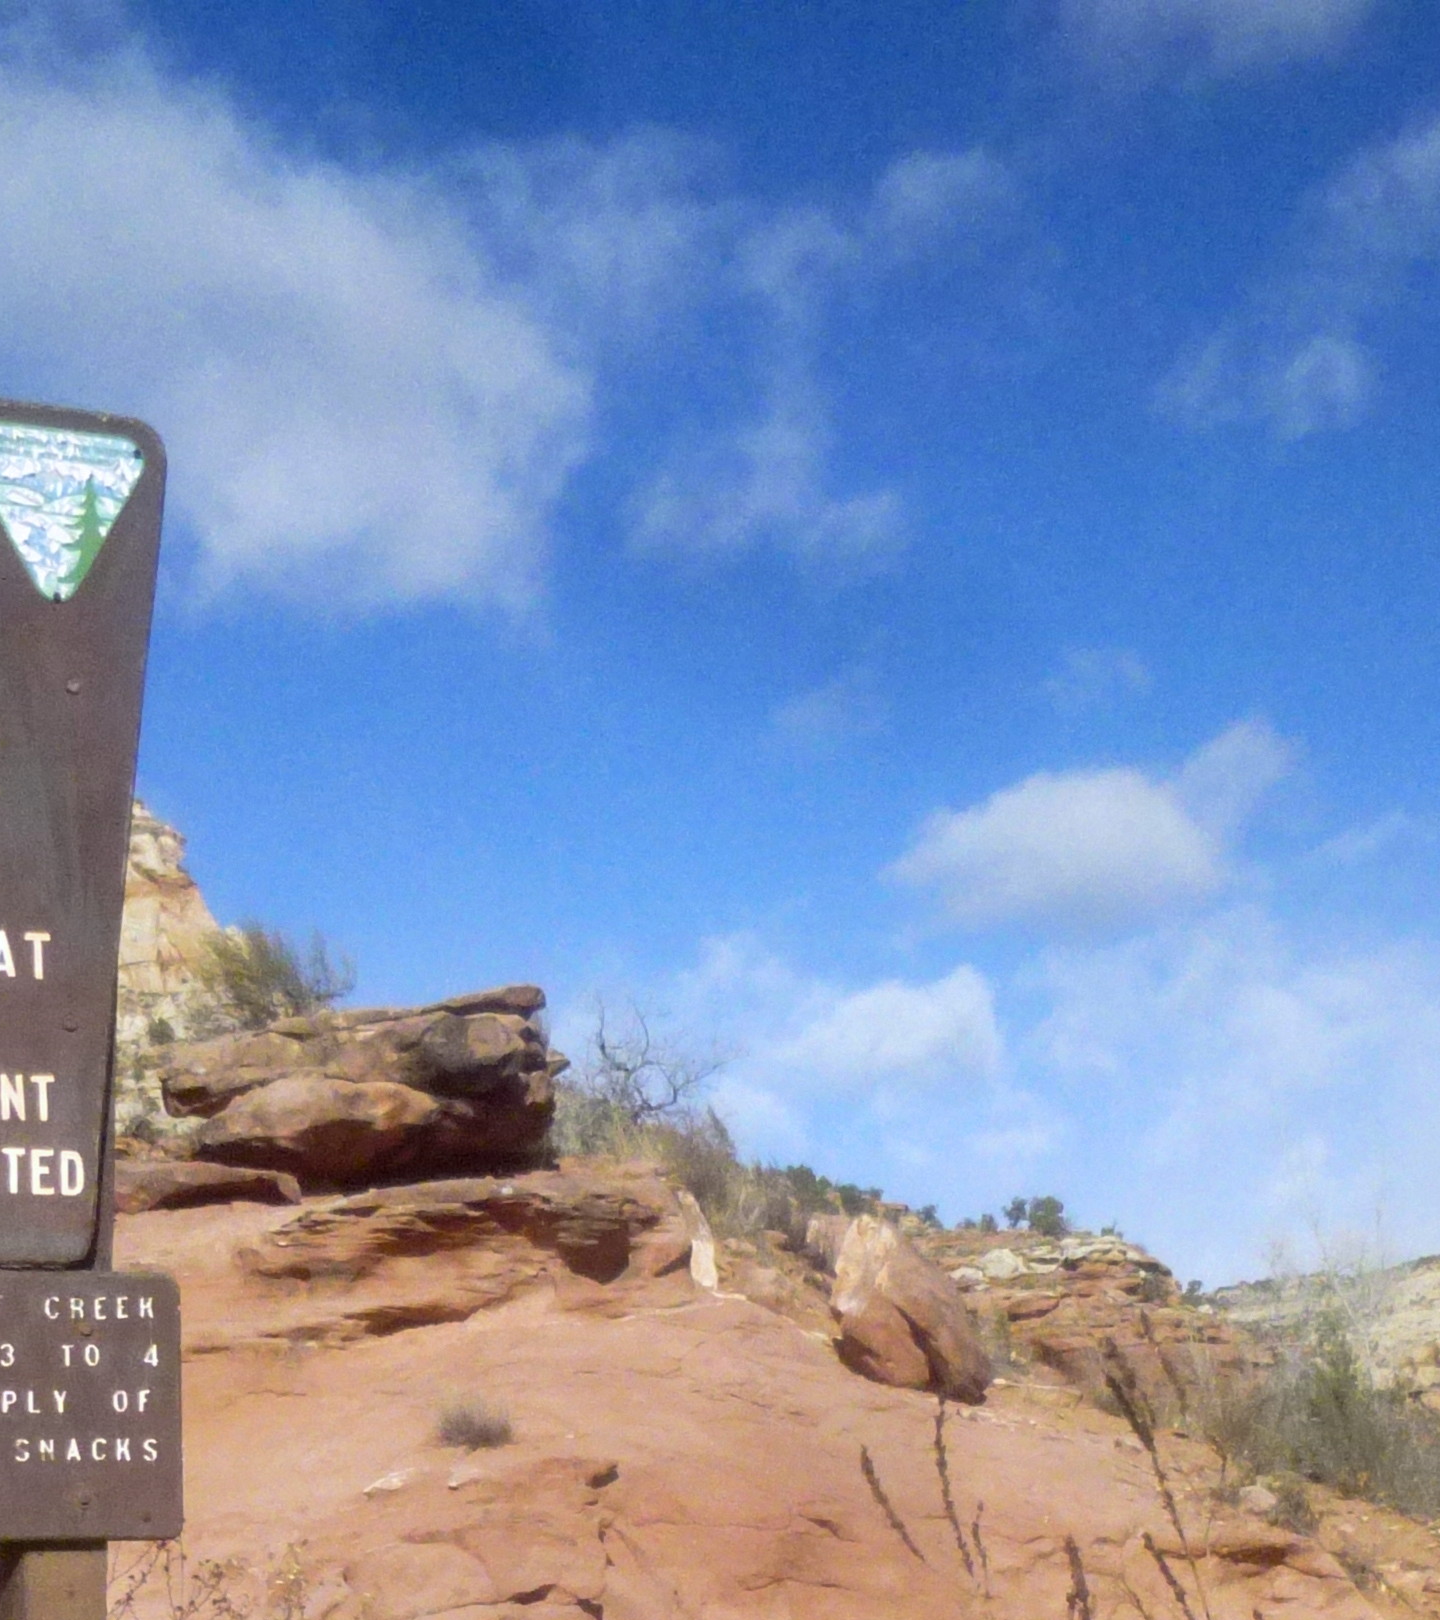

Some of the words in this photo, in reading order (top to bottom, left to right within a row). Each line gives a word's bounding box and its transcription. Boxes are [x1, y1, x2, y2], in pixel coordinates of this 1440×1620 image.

[44, 1296, 155, 1320] CREEK
[0, 1343, 15, 1367] 3
[61, 1343, 100, 1367] TO
[144, 1343, 159, 1368] 4
[112, 1389, 151, 1413] OF
[14, 1438, 160, 1464] SNACKS
